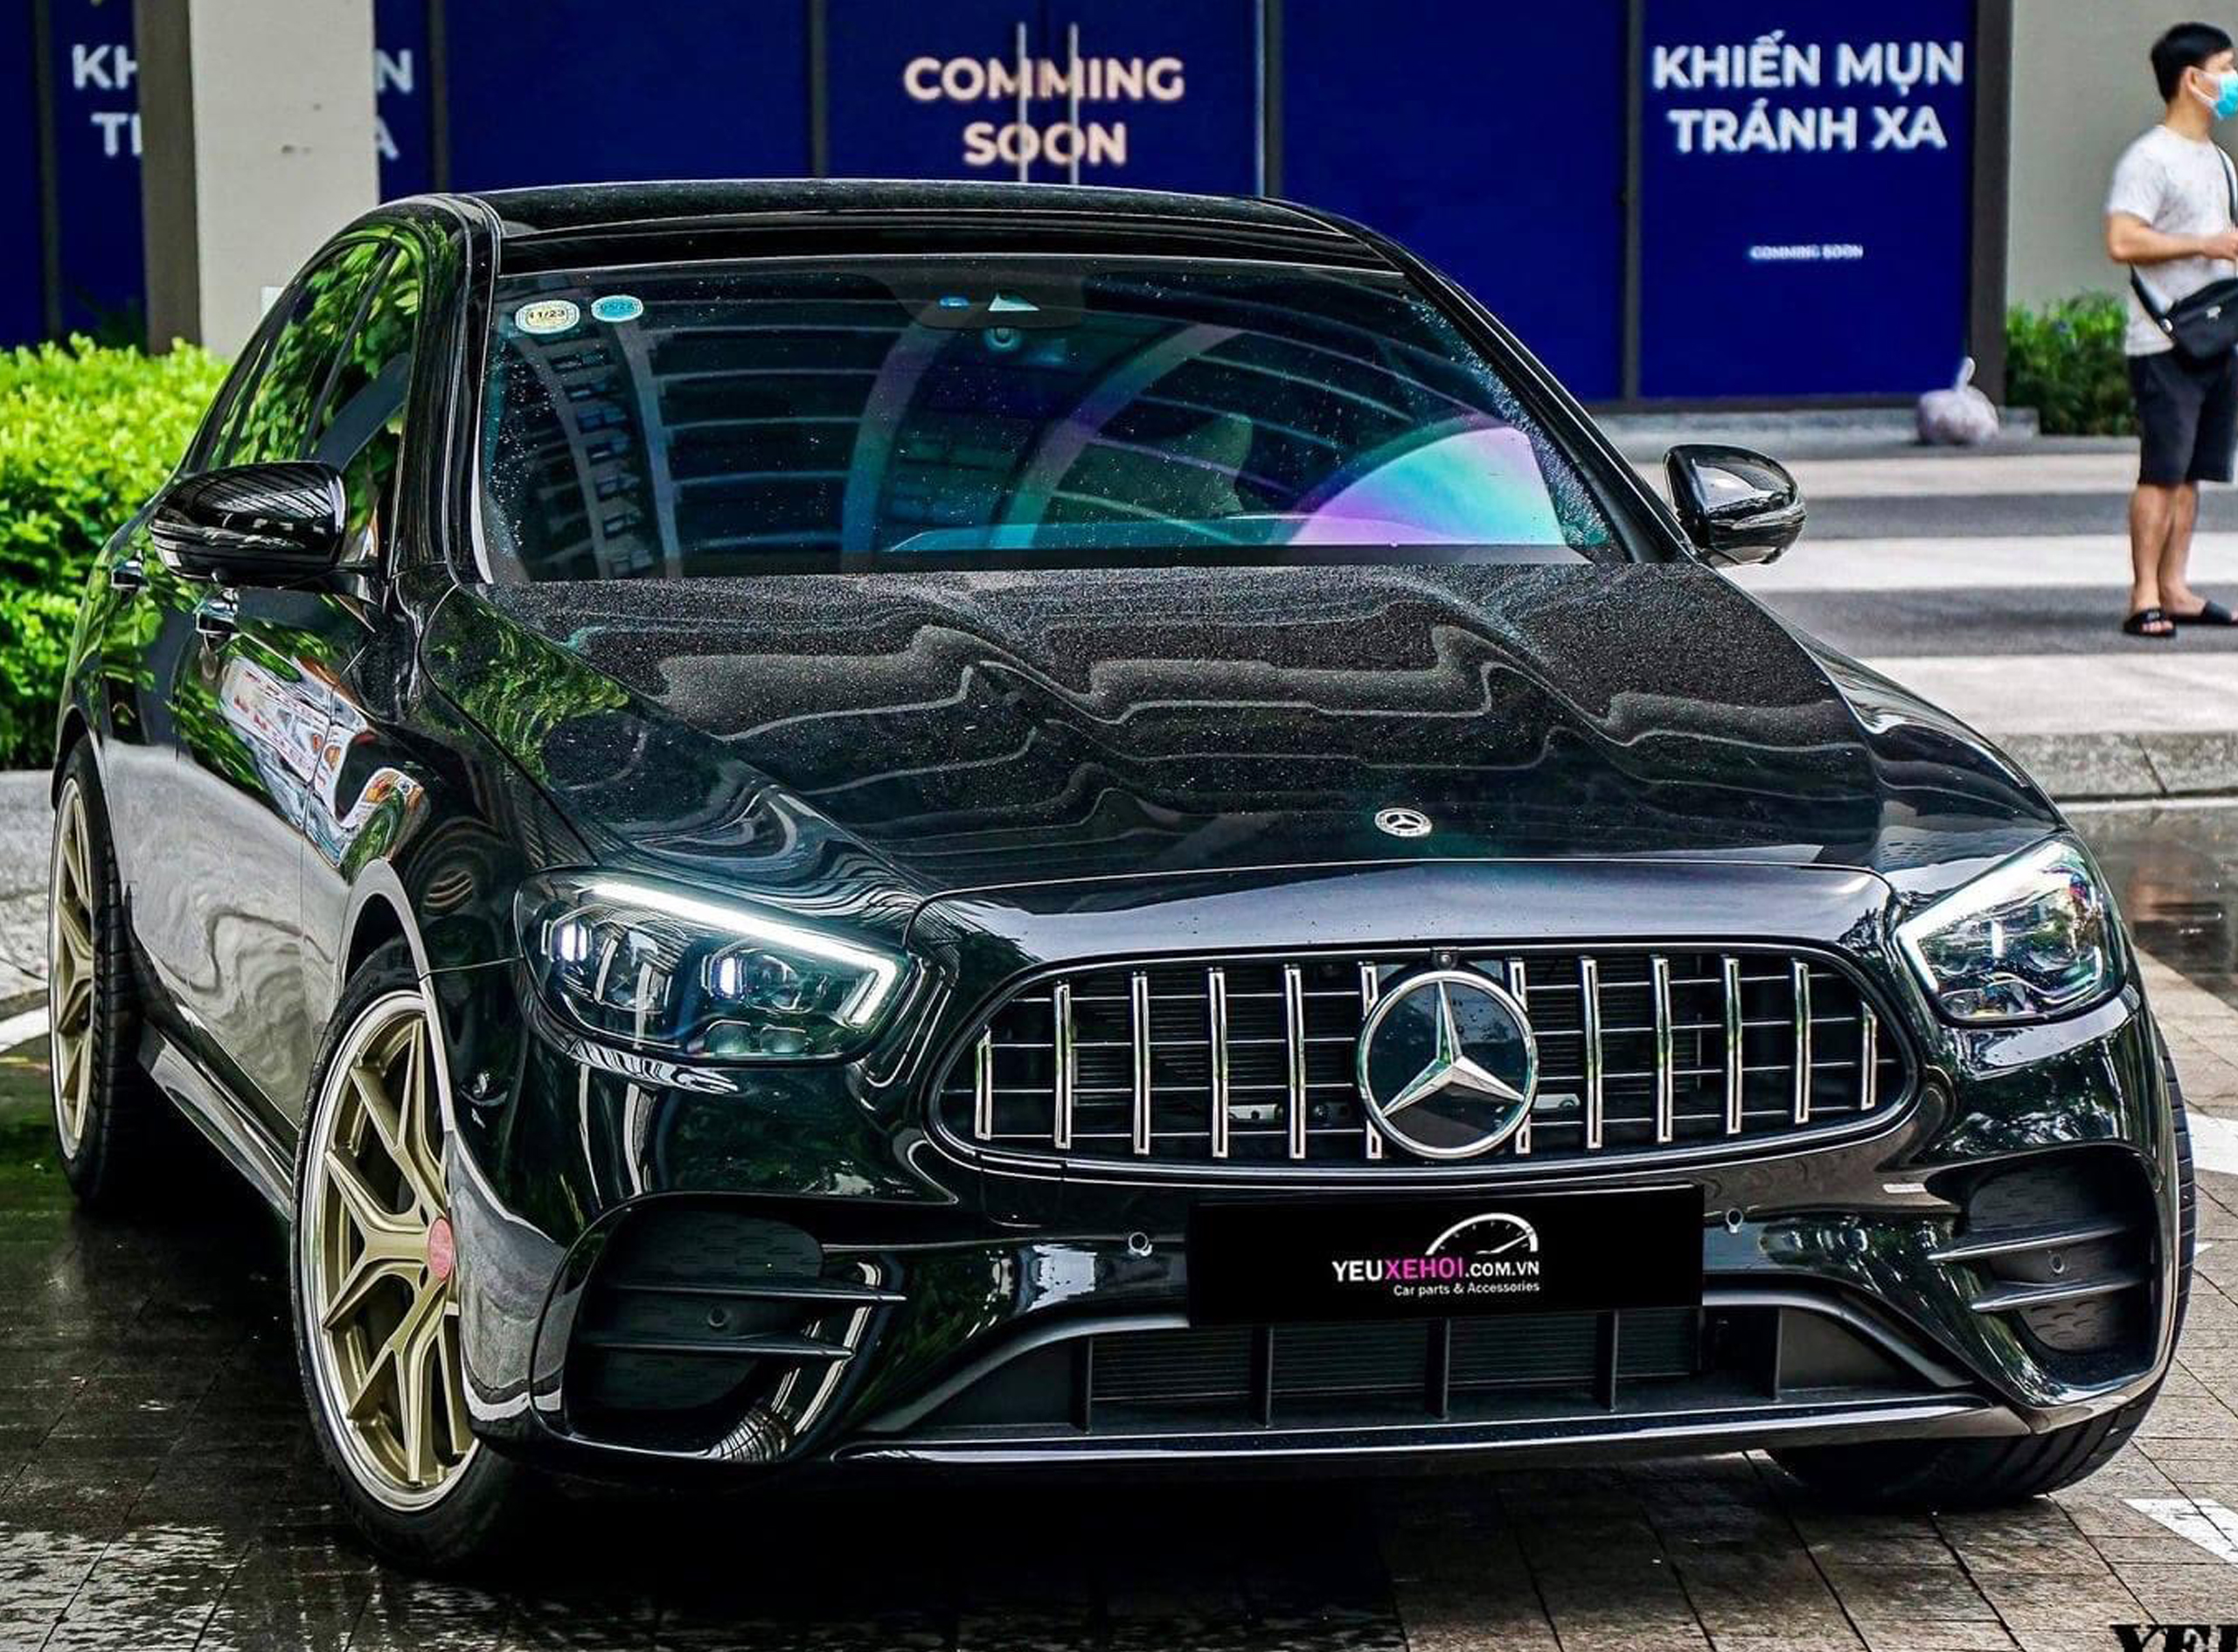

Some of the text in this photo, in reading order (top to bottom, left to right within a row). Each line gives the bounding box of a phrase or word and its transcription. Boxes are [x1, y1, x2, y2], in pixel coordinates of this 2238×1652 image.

[903, 58, 1185, 101] COMMING
[1653, 30, 1963, 96] KHIẾN MỤN
[963, 121, 1127, 165] SOON
[1667, 97, 1948, 152] TRÁNH XA
[1331, 1257, 1540, 1282] YEUXEHOI.COM.VN
[1394, 1281, 1540, 1297] Car parts & Accessories
